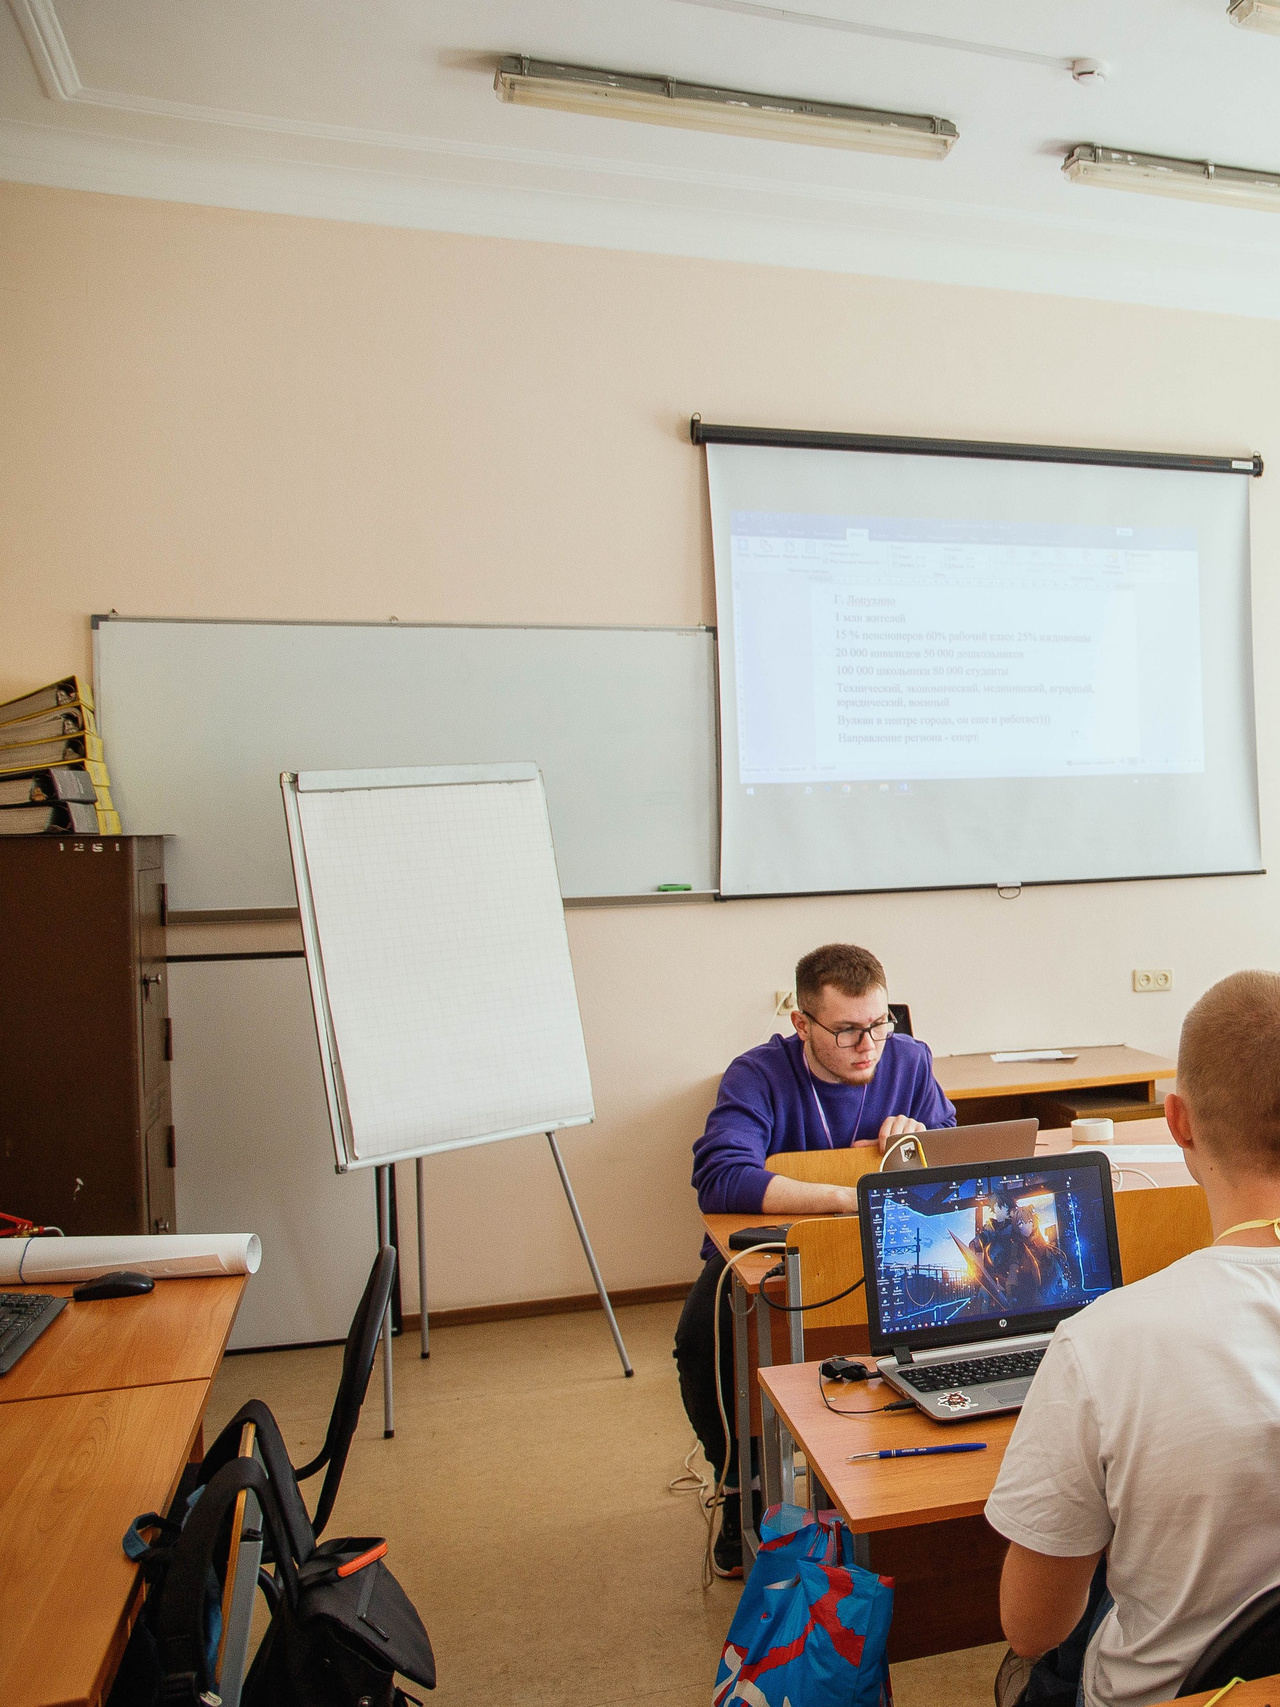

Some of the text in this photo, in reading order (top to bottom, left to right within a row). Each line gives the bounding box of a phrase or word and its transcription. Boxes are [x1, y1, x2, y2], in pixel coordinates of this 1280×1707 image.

[843, 615, 863, 623] млн
[866, 614, 906, 623] жителей
[835, 631, 1091, 644] 15 % пенсионеров 60% рабочий класс 25% иждивенцы
[835, 648, 1024, 659] 20 000 инвалидов 50 000 дошкольников
[837, 666, 1008, 677] 100 000 школьники 80 000 студенты
[836, 683, 1096, 696] Технический, экономический, медицинский, аграрный,
[837, 698, 950, 709] юридический, военный
[838, 715, 874, 726] Вулкан
[885, 717, 917, 726] центре
[920, 717, 955, 726] города,
[838, 733, 902, 744] Направление
[904, 734, 942, 744] региона
[951, 734, 977, 743] спорт
